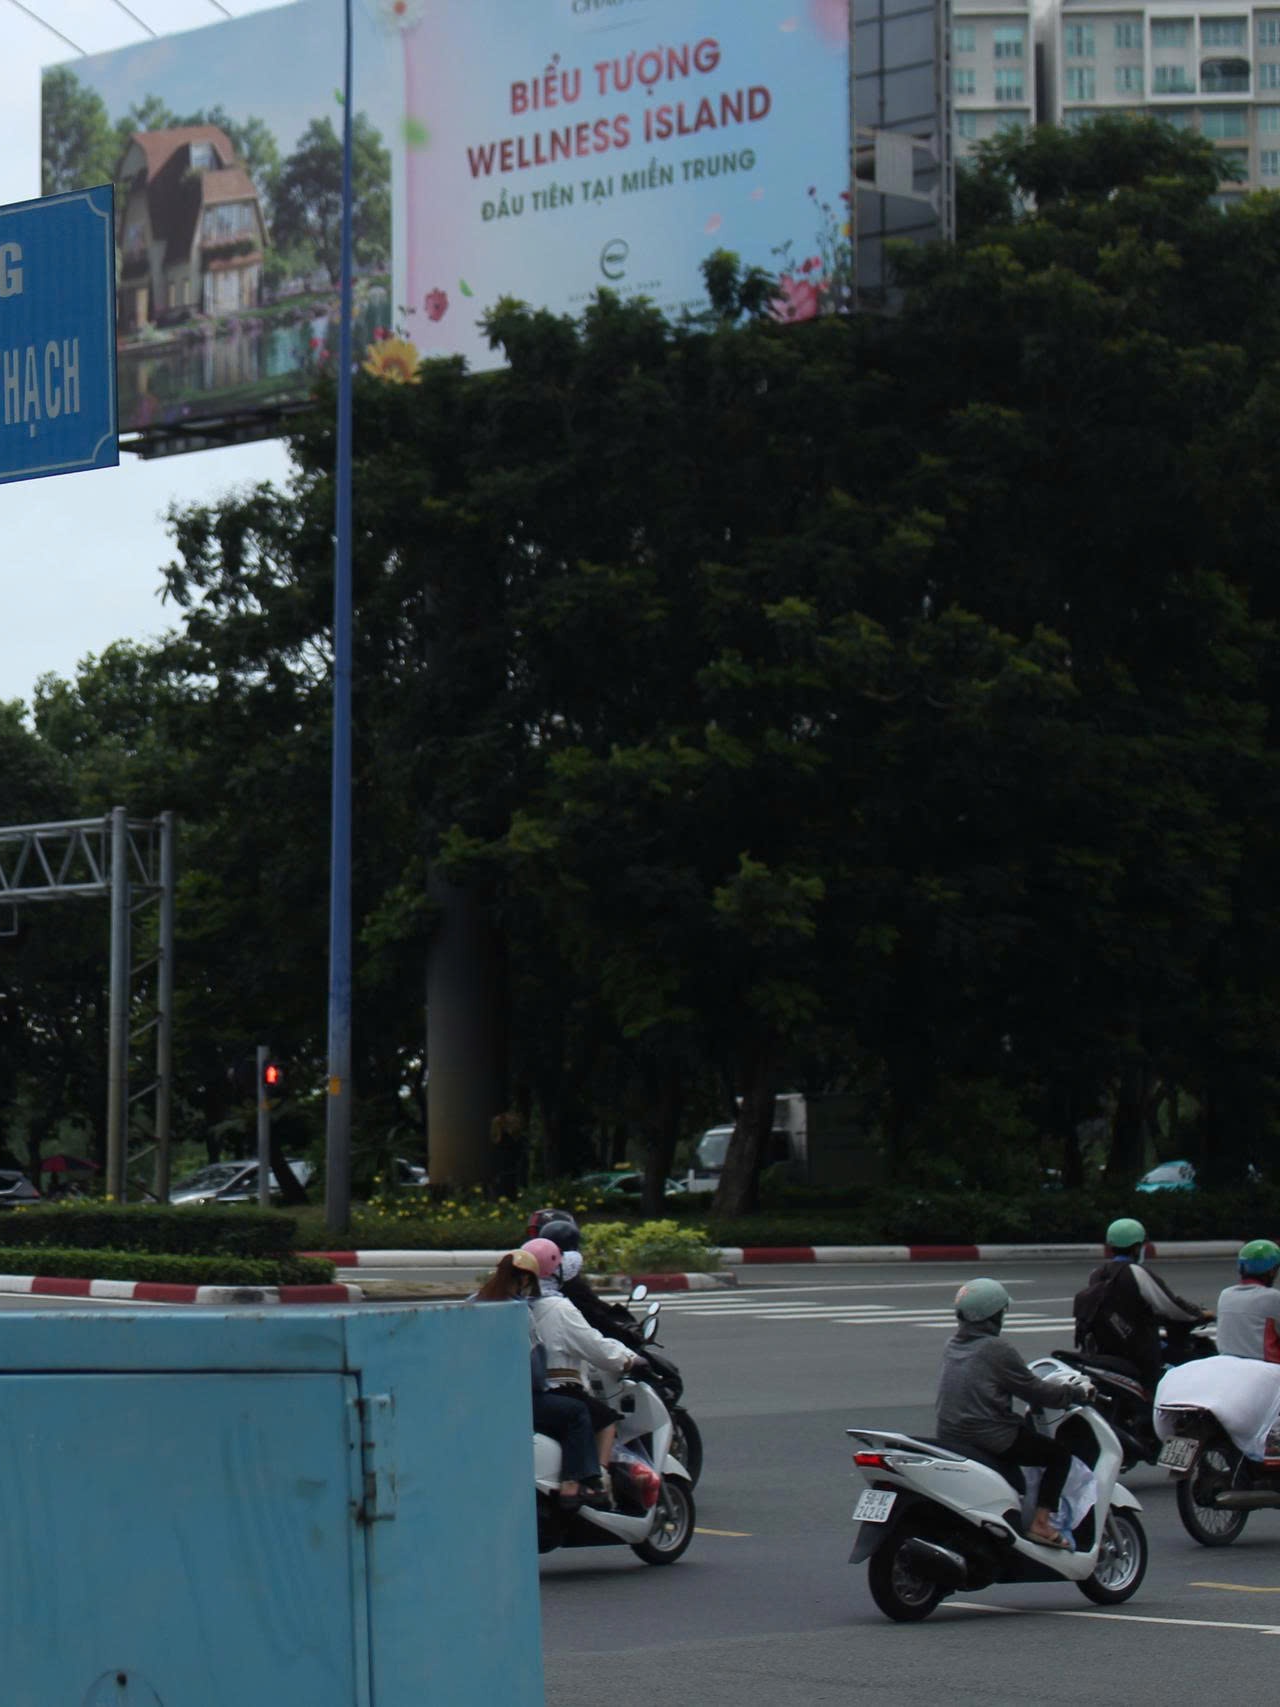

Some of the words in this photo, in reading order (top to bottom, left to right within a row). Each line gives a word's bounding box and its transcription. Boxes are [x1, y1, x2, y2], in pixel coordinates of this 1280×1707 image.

[510, 53, 582, 116] BIỂU
[594, 38, 721, 97] TƯỢNG
[467, 113, 631, 180] WELLNESS
[643, 85, 773, 144] ISLAND
[532, 180, 575, 212] TIÊN
[581, 177, 614, 207] TẠI
[682, 148, 757, 182] TRUNG
